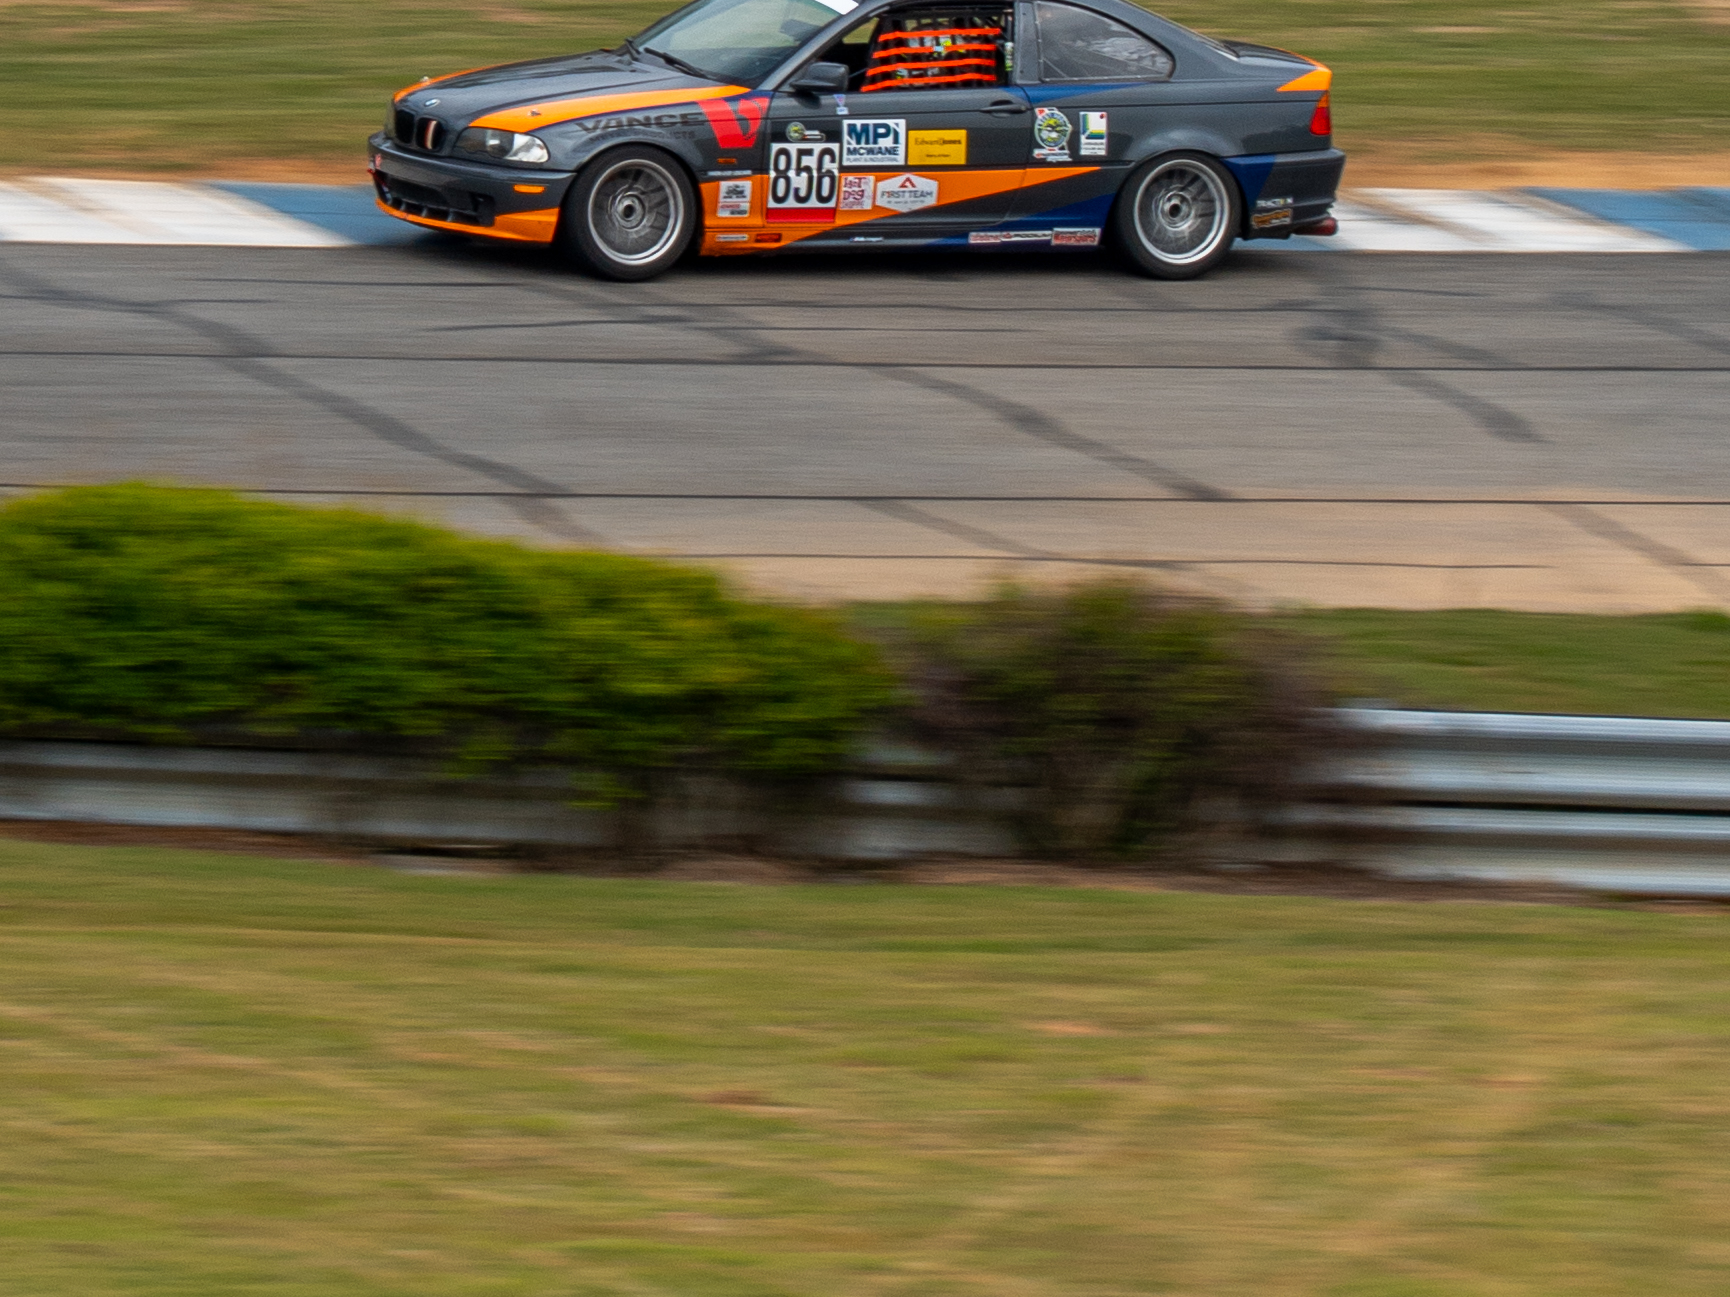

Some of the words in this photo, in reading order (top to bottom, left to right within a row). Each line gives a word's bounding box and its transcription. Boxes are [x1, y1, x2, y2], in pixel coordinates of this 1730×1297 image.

[575, 112, 705, 133] VANCE
[846, 146, 899, 156] MCWANE
[771, 147, 836, 204] 856
[881, 190, 906, 198] FIRST
[907, 190, 933, 198] TEAM
